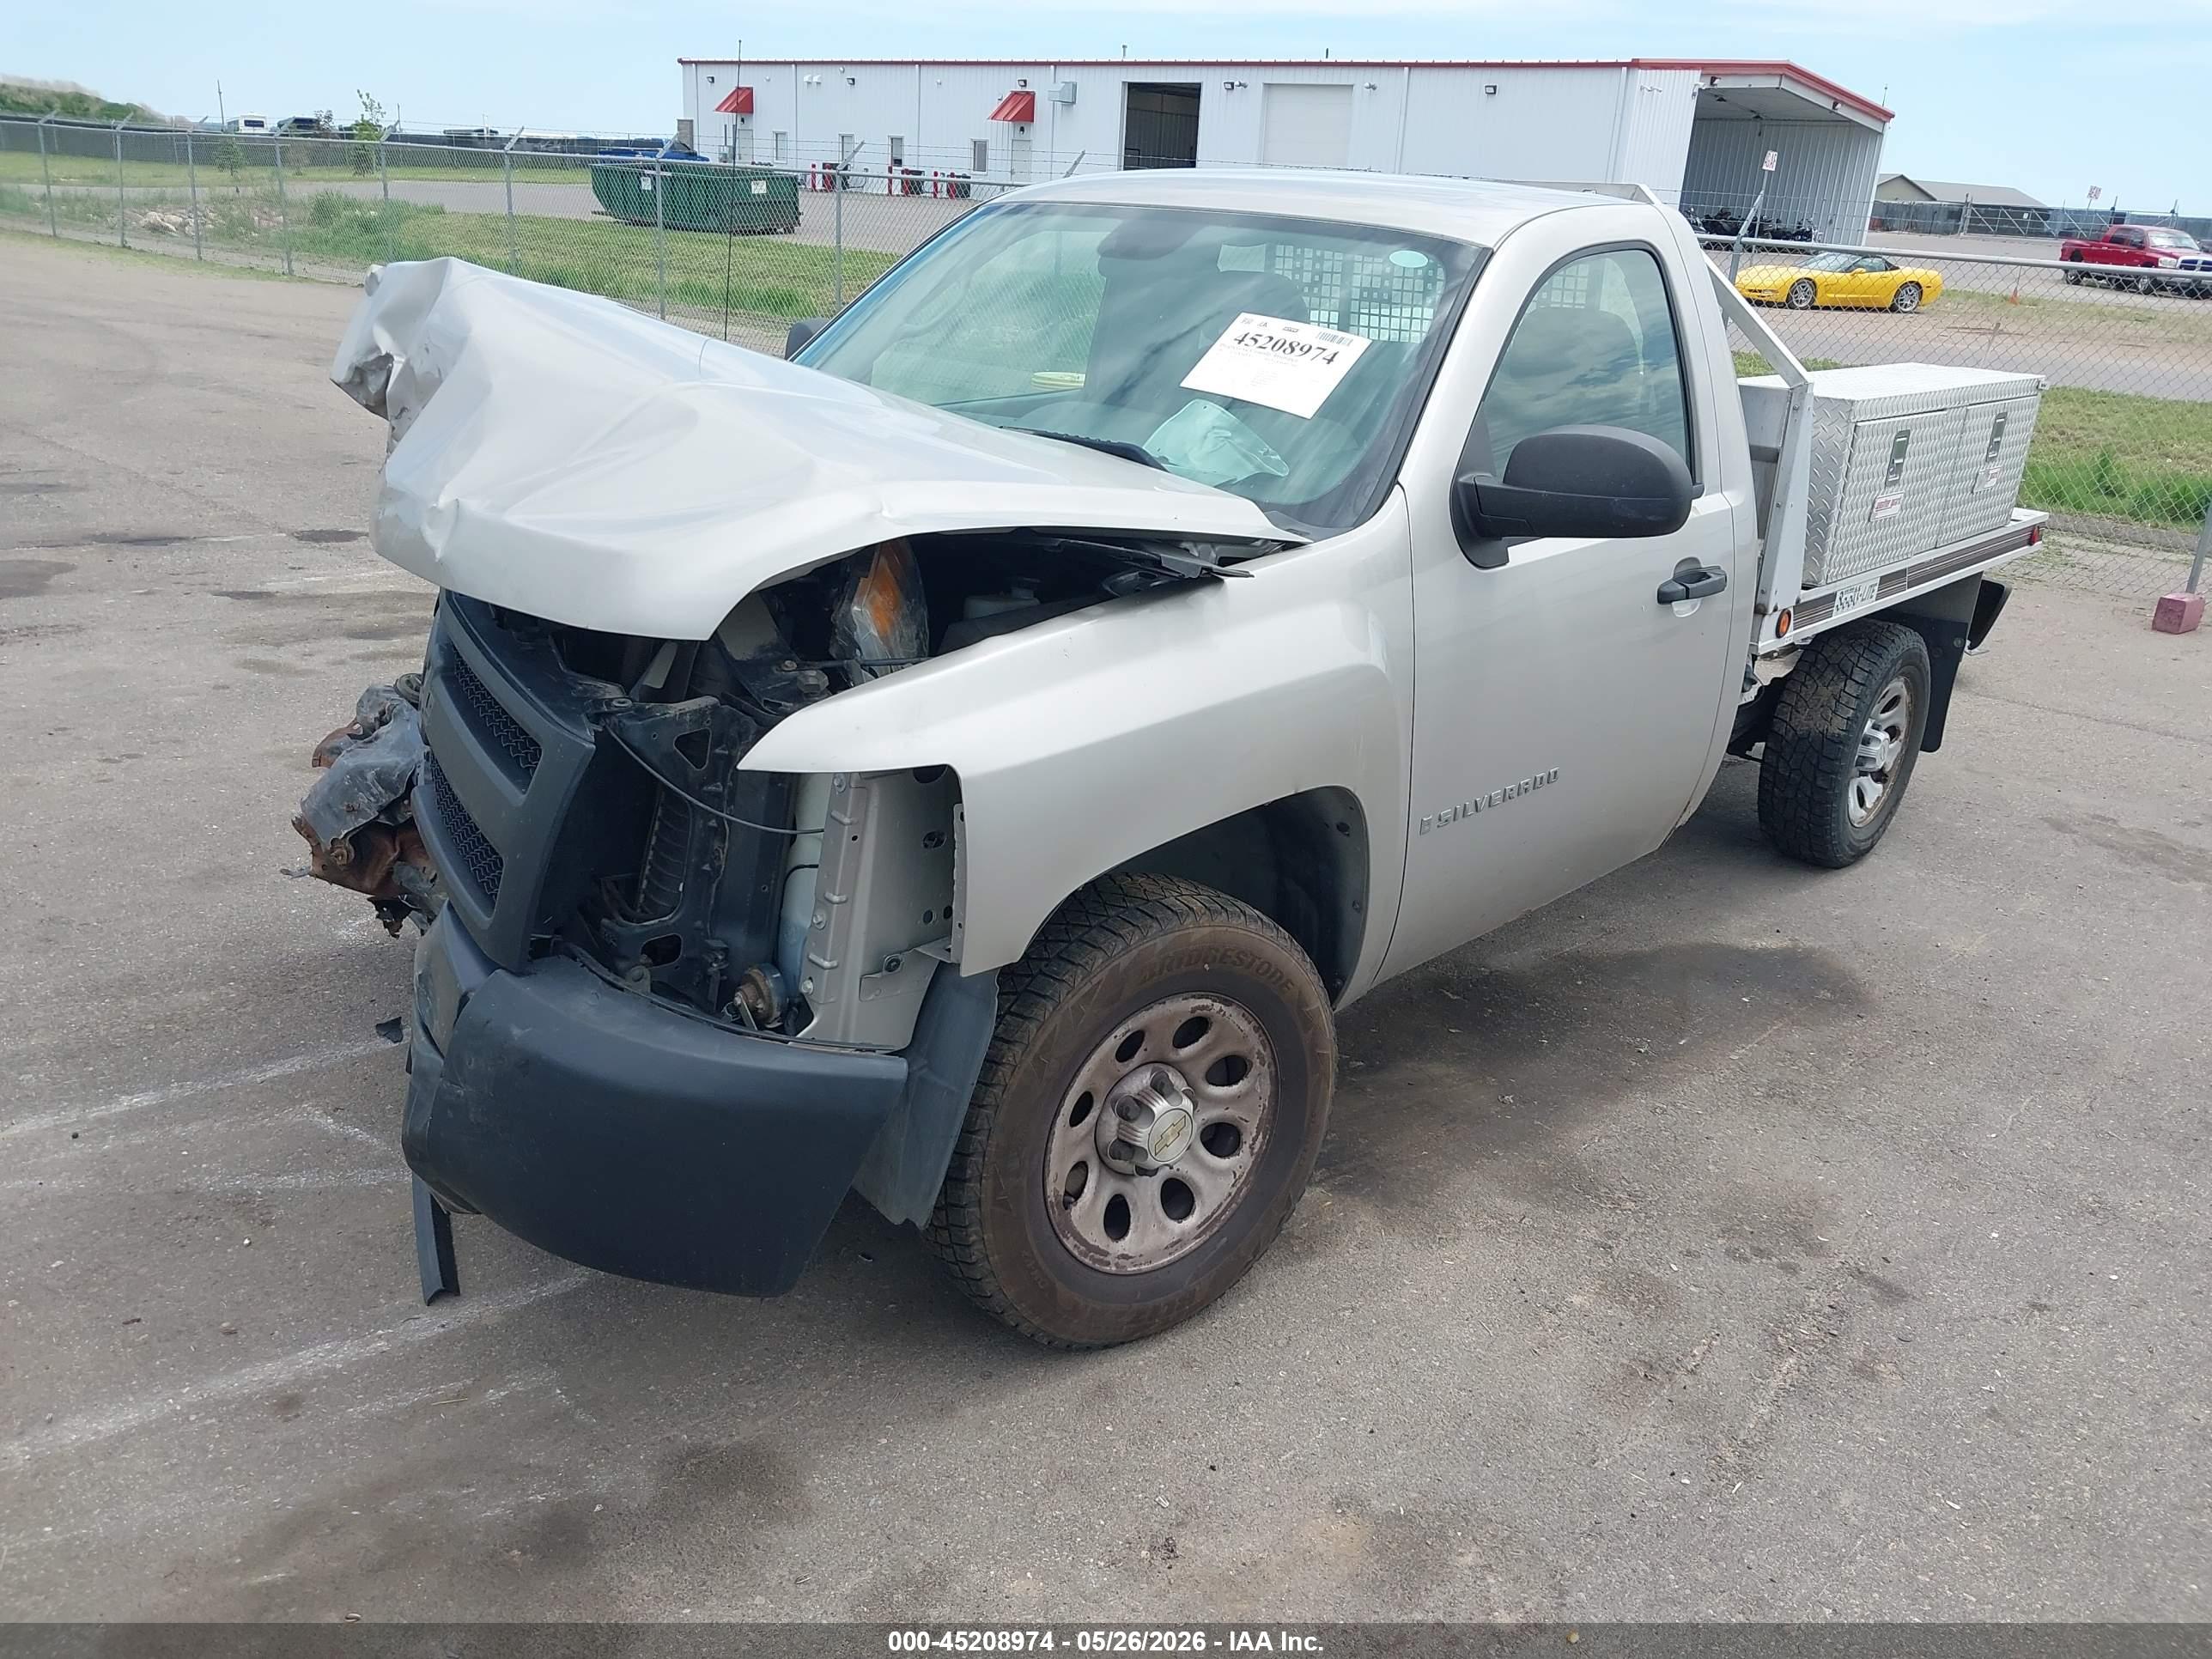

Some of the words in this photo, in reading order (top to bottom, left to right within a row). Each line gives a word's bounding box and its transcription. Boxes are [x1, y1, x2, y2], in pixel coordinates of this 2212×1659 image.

[1234, 331, 1340, 365] 45208974
[1437, 766, 1560, 828] SILVERADO
[1140, 945, 1296, 993] BRIDGESTONE
